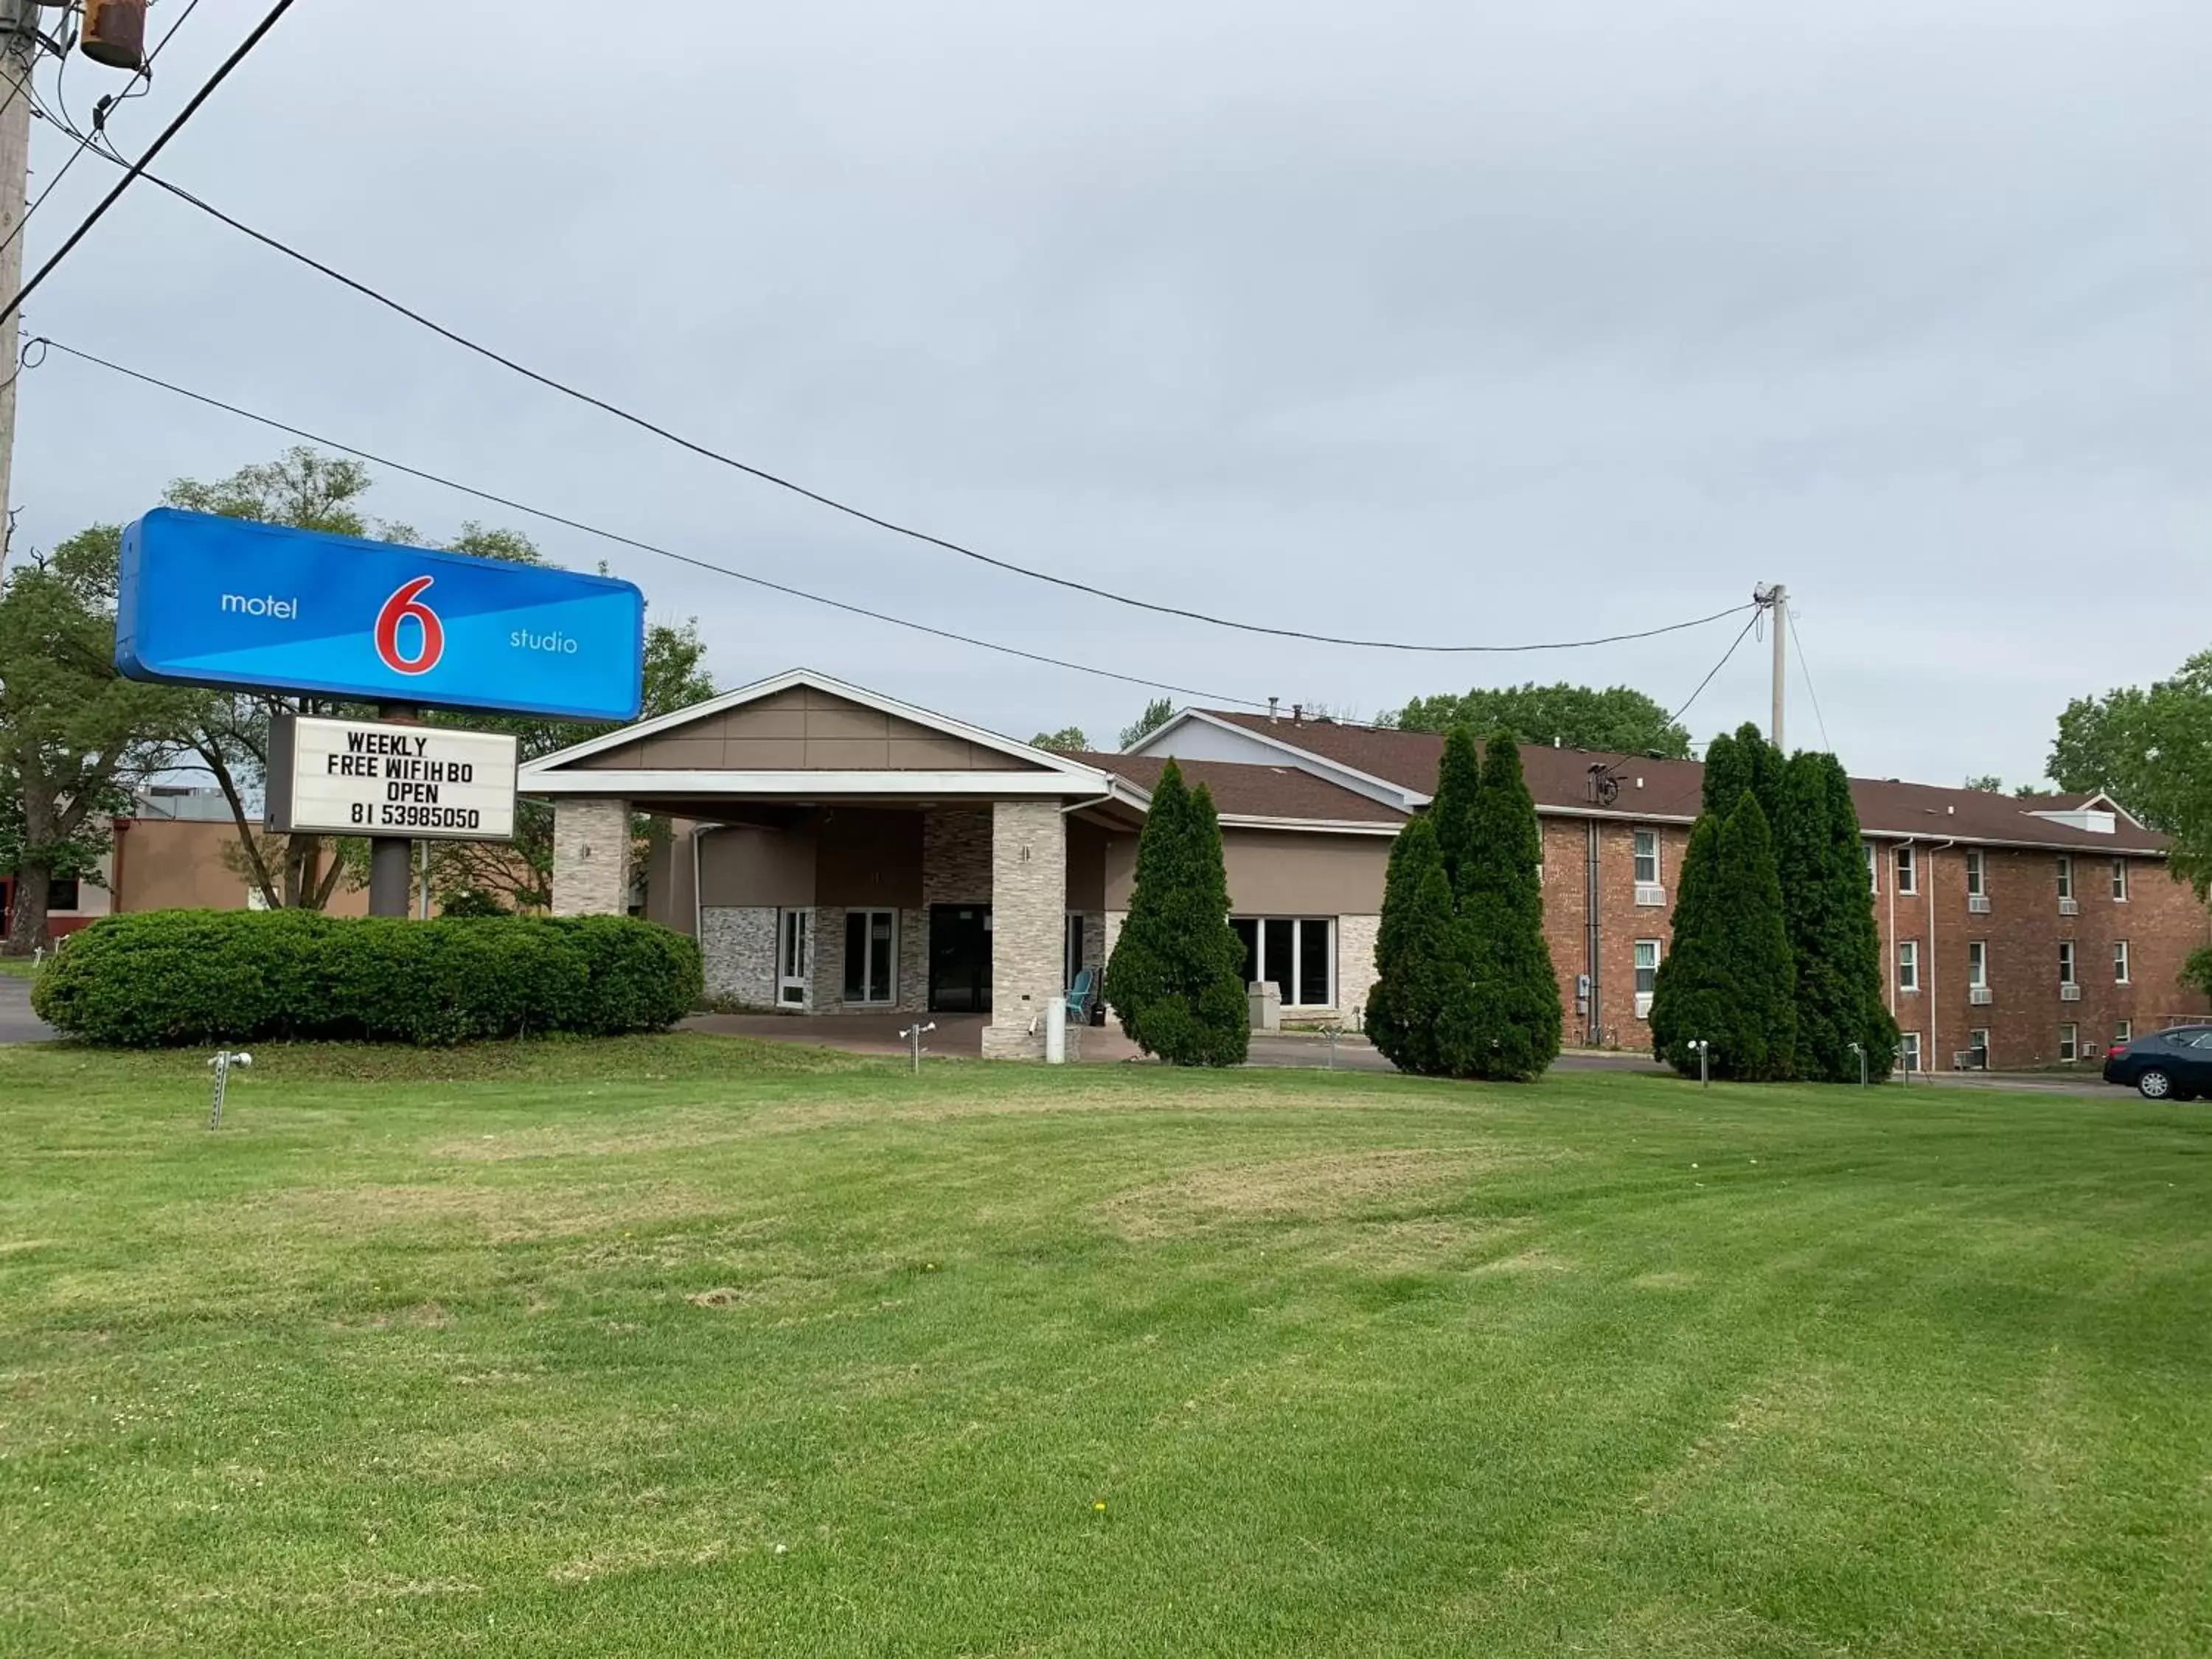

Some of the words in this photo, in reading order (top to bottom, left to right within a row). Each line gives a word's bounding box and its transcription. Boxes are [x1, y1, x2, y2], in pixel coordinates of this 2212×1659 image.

[221, 594, 297, 620] motel
[374, 574, 445, 676] 6
[509, 629, 578, 653] studio
[347, 731, 427, 757] WEEKLY
[327, 754, 378, 777] FREE
[386, 781, 439, 804] OPEN
